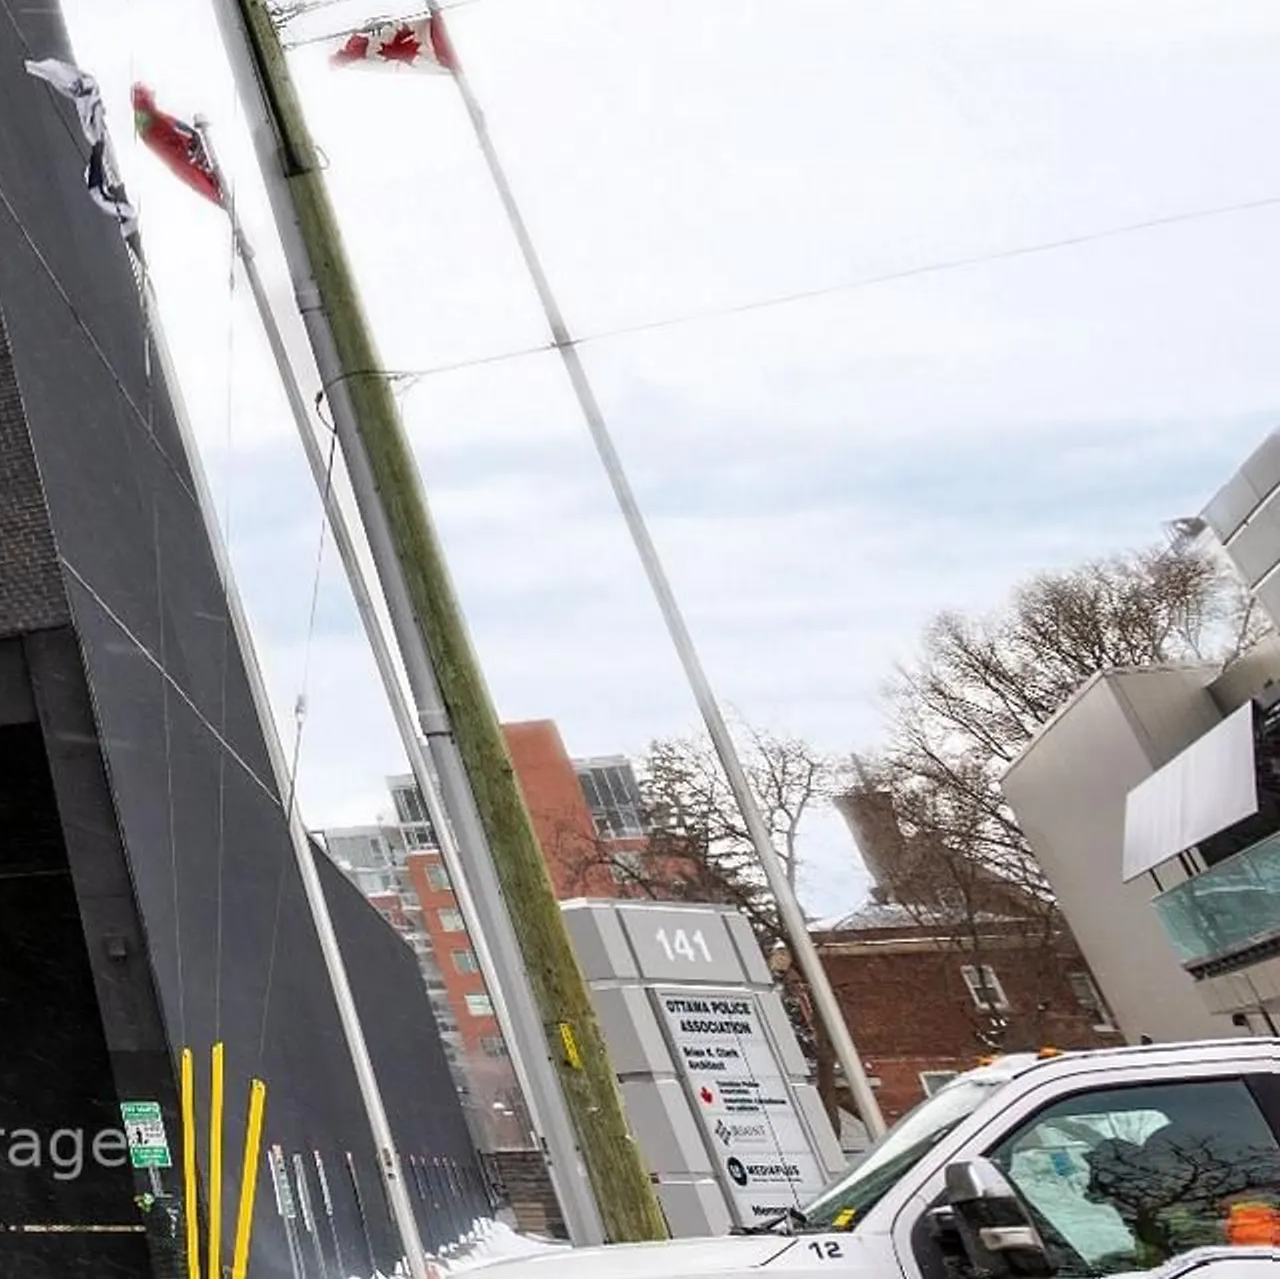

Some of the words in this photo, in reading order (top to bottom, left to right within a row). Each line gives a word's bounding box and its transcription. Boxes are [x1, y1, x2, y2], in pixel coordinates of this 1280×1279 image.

[655, 928, 712, 963] 141
[666, 1000, 710, 1014] OTTAWA
[711, 1001, 751, 1015] POLICE
[680, 1020, 752, 1035] ASSOCIATION
[808, 1241, 844, 1260] 12
